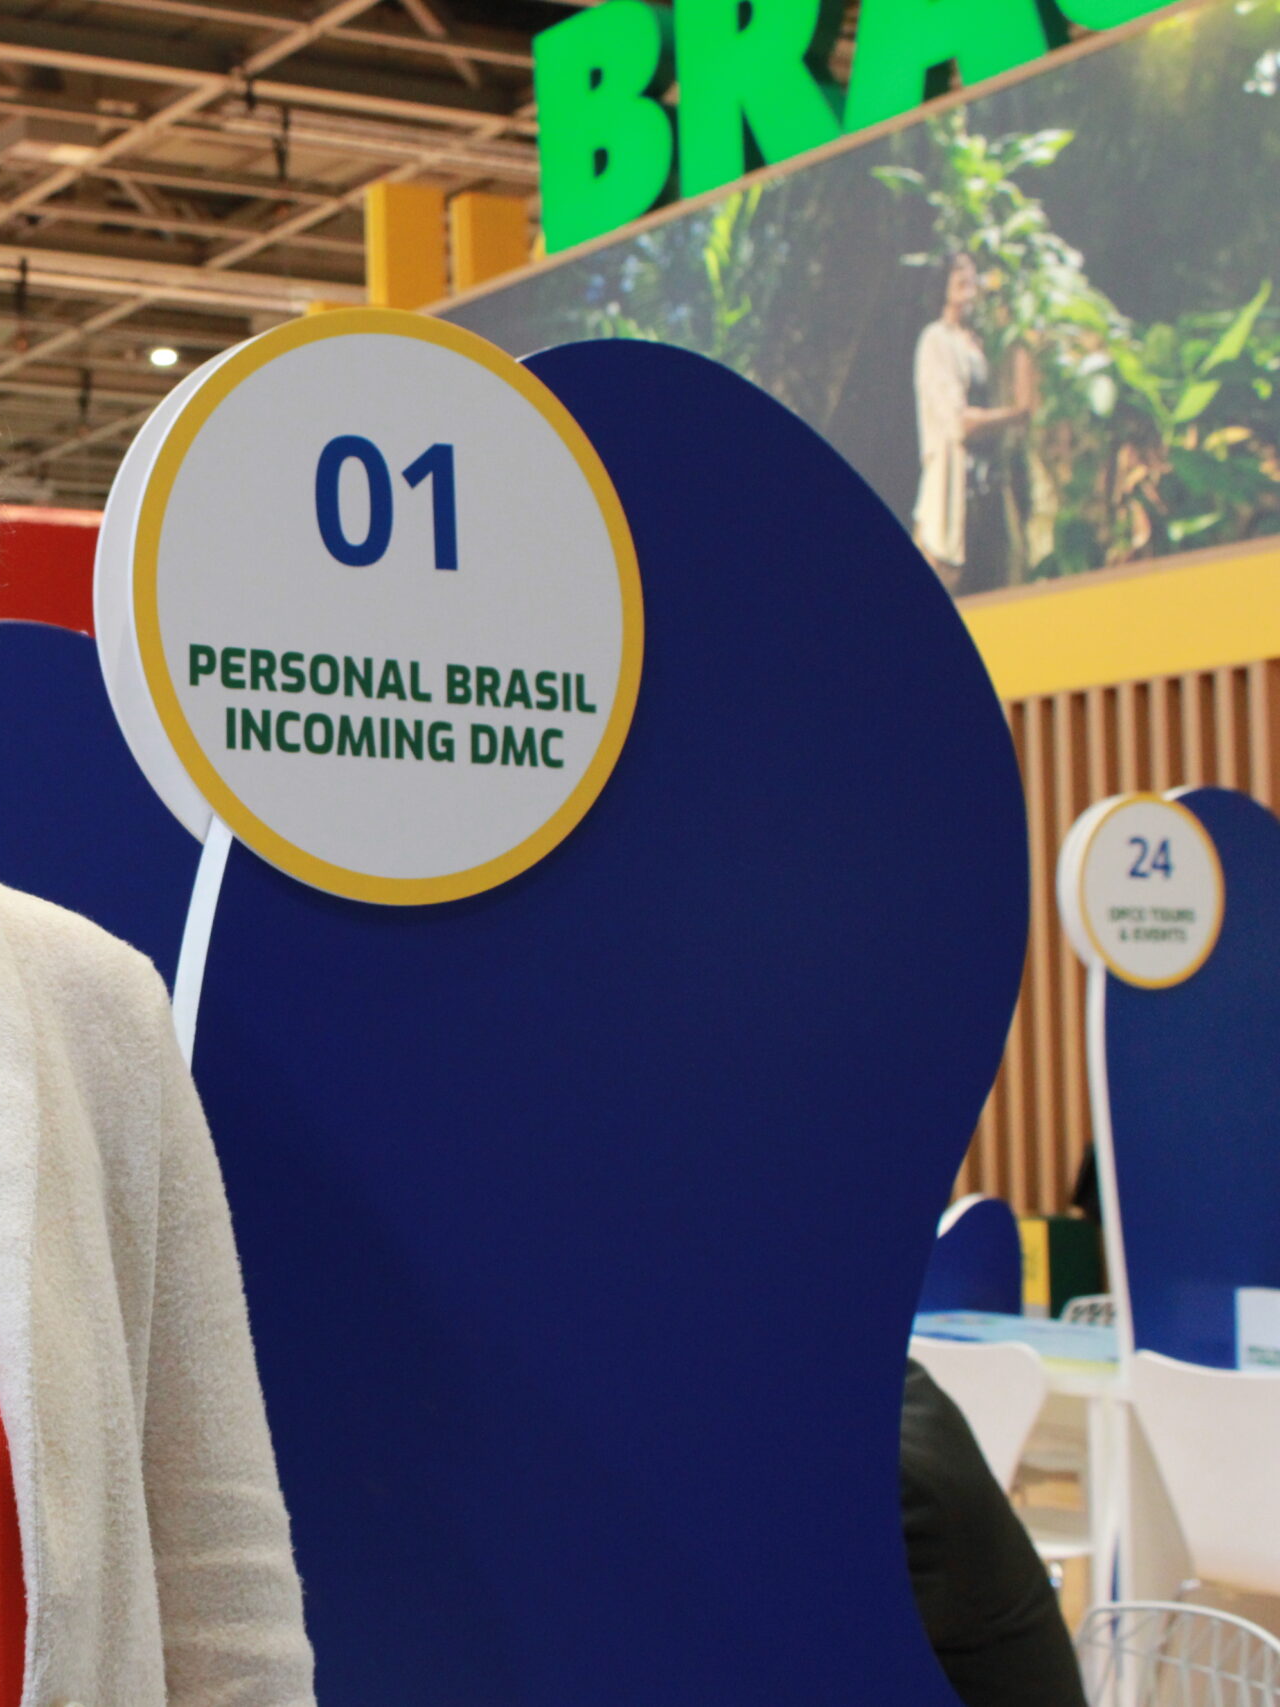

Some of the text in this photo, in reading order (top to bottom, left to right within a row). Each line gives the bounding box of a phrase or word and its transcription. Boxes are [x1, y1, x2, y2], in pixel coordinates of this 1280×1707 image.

[315, 434, 458, 571] 01
[189, 643, 599, 715] PERSONAL BRASIL
[226, 707, 566, 770] INCOMING DMC
[1128, 836, 1174, 879] 24
